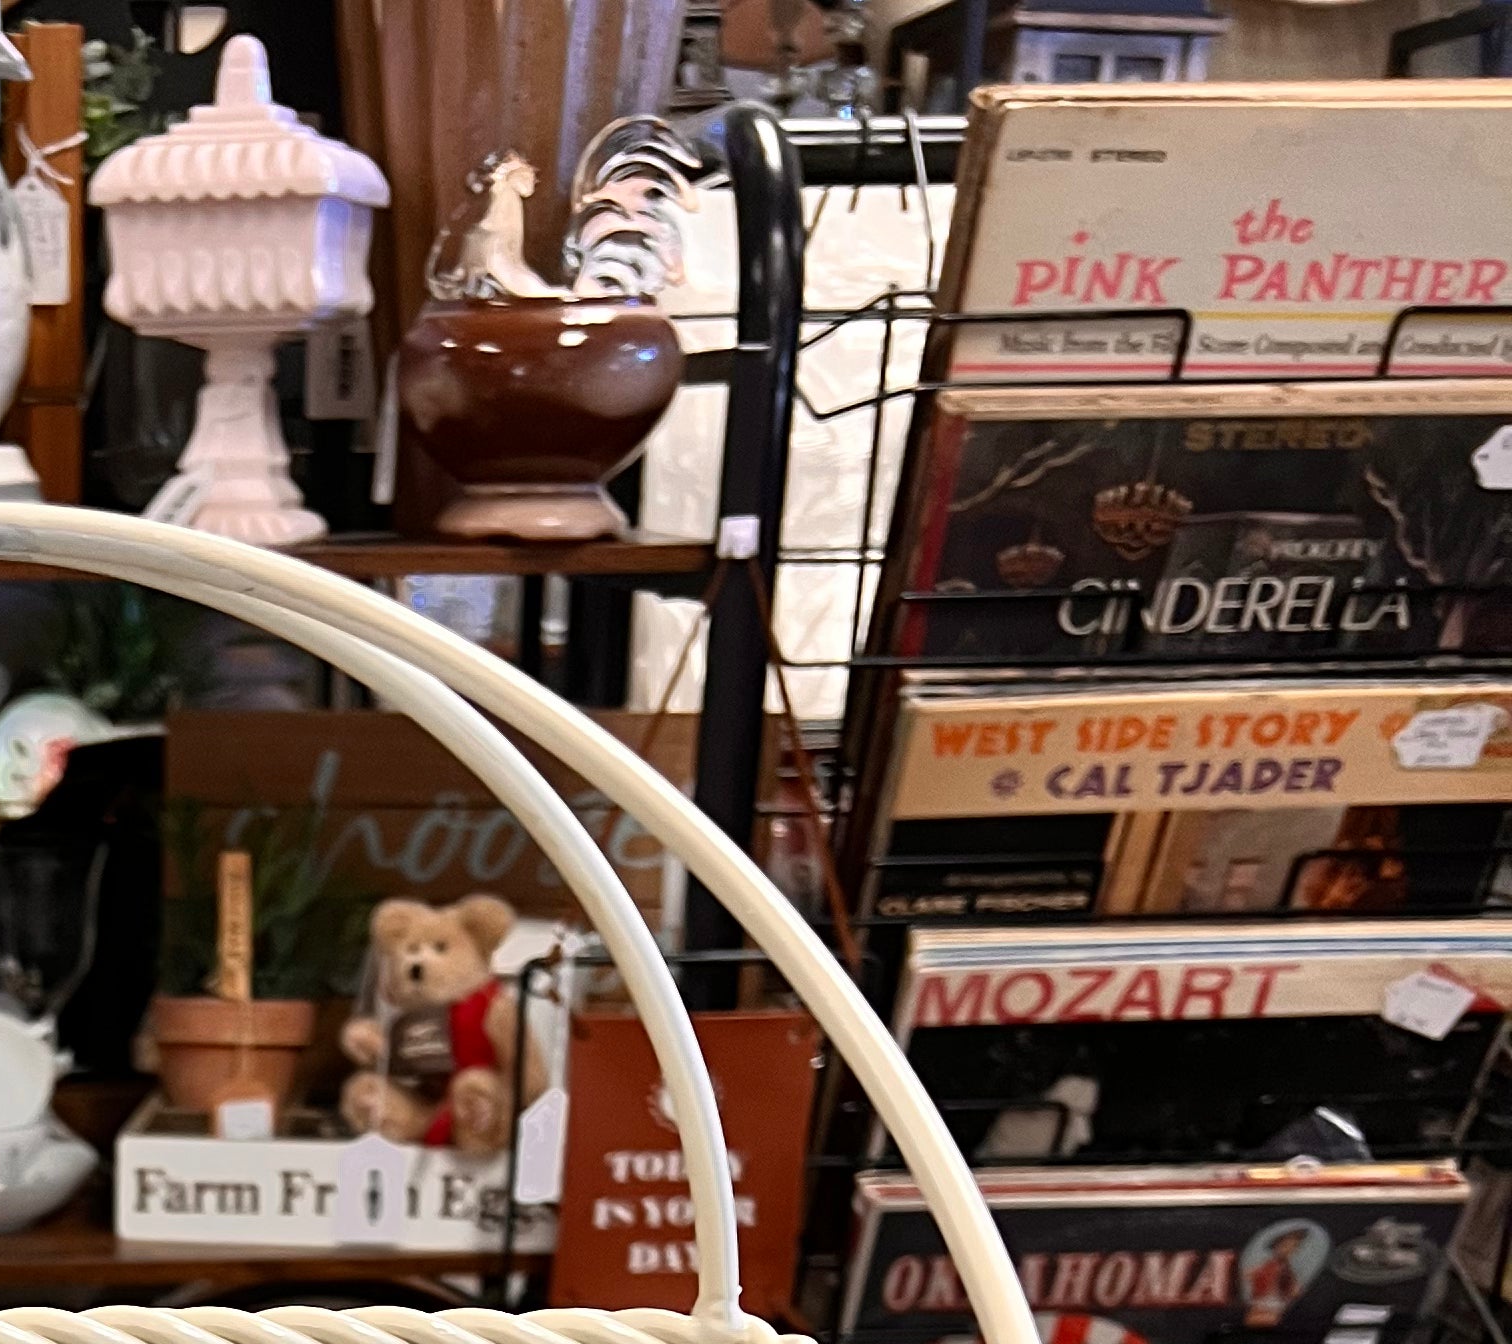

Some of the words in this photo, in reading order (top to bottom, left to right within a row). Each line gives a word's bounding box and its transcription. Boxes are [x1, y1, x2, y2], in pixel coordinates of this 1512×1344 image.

[1233, 198, 1315, 246] the
[1012, 230, 1182, 306] PINK
[1217, 252, 1508, 304] PANTHER
[1185, 421, 1372, 451] STEREO
[1057, 576, 1412, 636] CINDERELLA
[931, 719, 1059, 758] WEST
[1076, 714, 1179, 754] SIDE
[1195, 709, 1361, 750] STORY
[1045, 764, 1133, 800] CAL
[1156, 757, 1345, 796] TJADER
[913, 963, 1300, 1027] MOZART
[134, 1167, 261, 1216] Farm
[883, 1247, 1241, 1312] OKAHOMA
